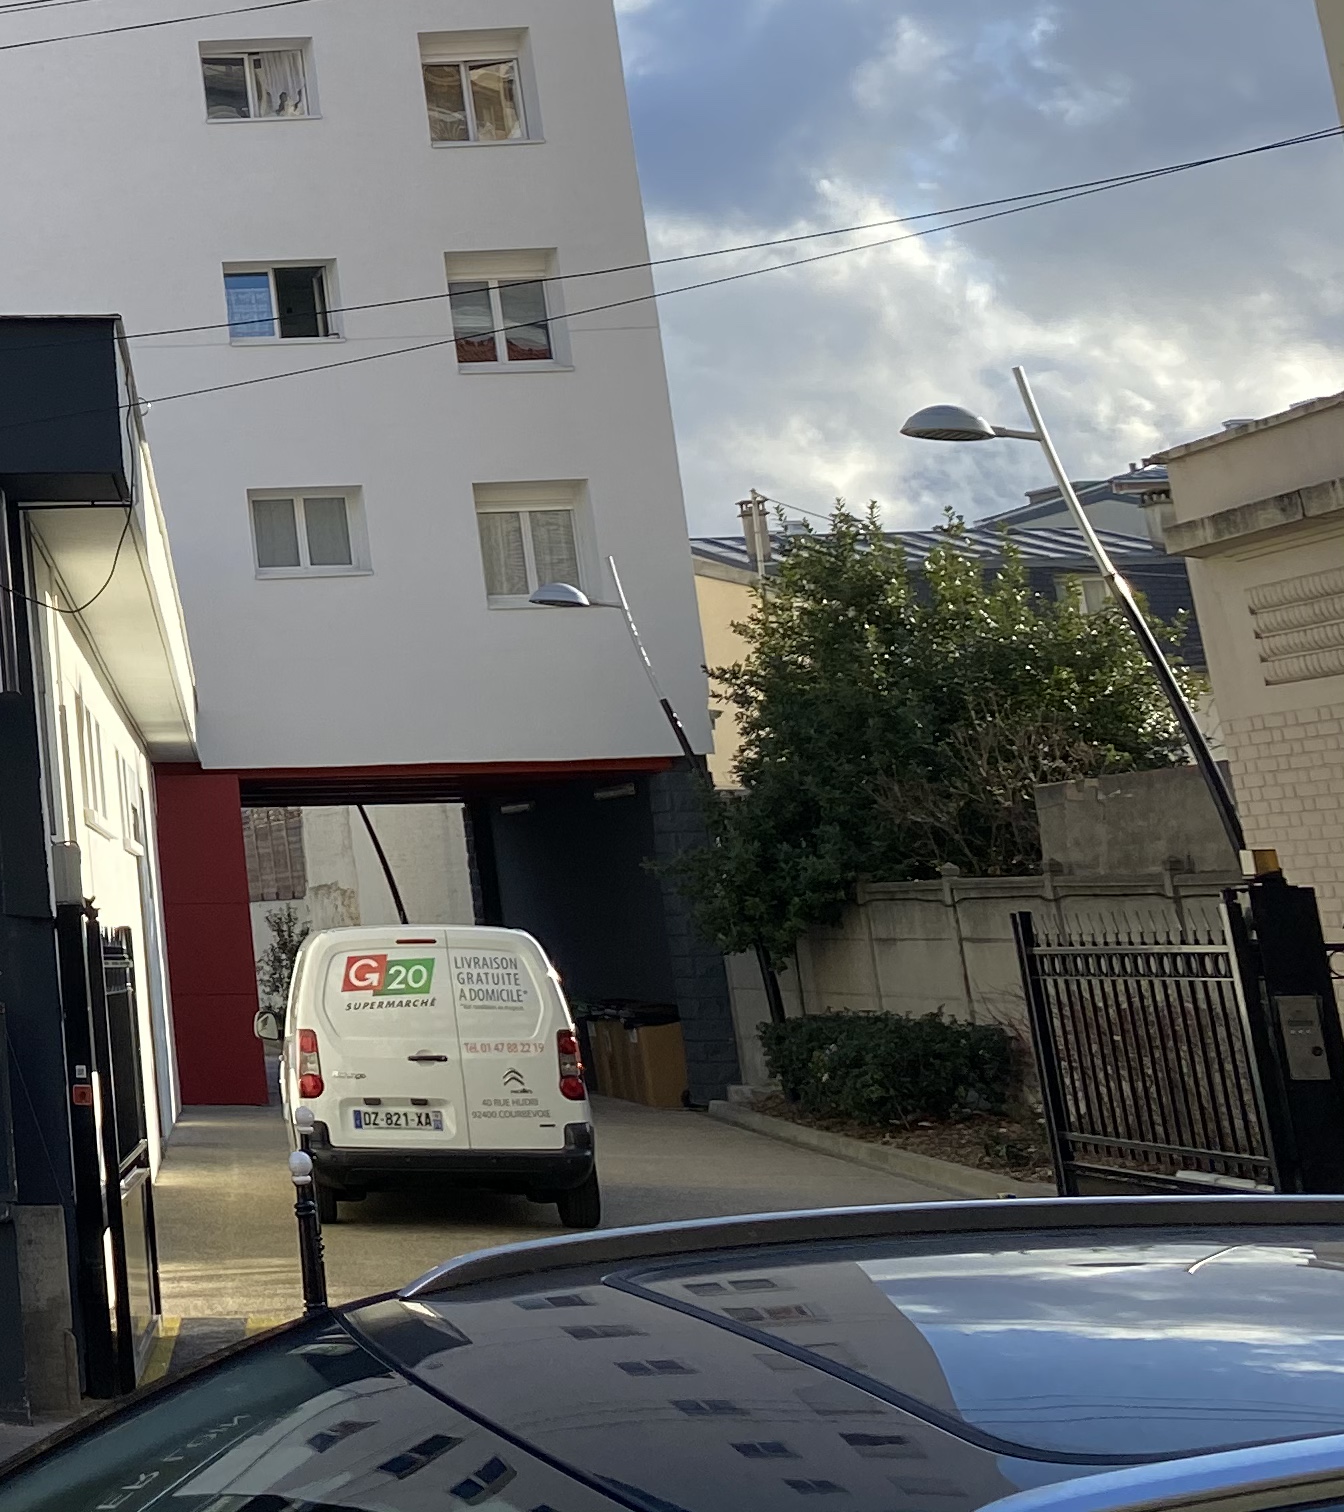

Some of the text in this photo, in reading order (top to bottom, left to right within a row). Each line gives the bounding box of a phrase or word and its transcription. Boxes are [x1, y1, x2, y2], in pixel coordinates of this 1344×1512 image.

[454, 956, 518, 970] LIVRAISON
[457, 972, 521, 986] GRATUITE
[345, 996, 437, 1011] SUPERMARCHÉ
[363, 1111, 433, 1127] DZ-821-XA
